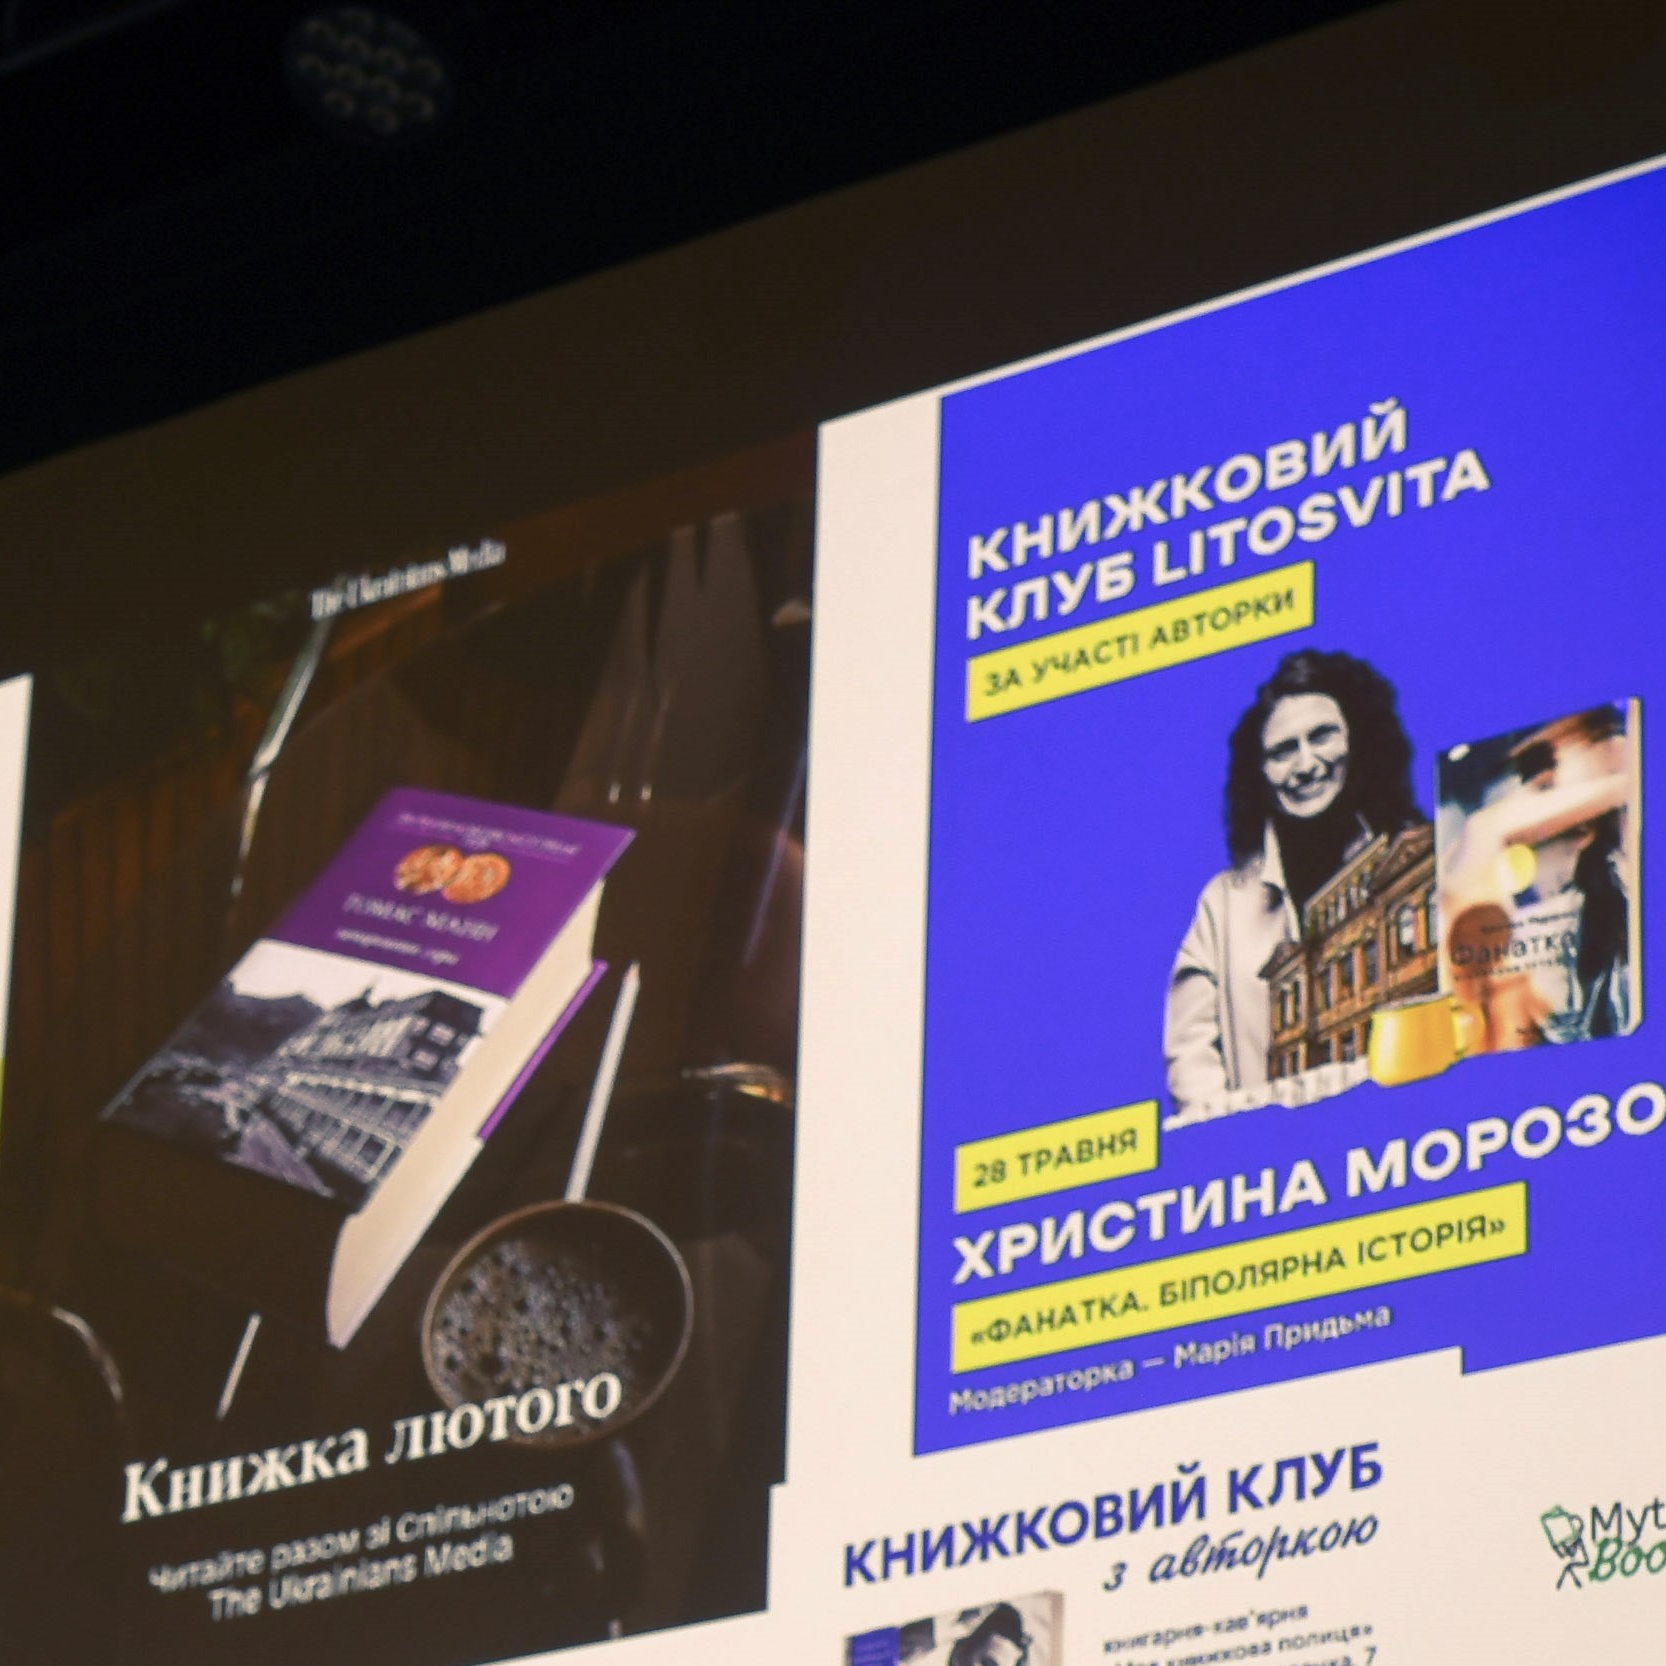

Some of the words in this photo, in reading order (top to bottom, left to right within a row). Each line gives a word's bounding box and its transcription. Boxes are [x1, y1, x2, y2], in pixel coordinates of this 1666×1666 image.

[967, 551, 1135, 640] КЛУБ
[1153, 448, 1491, 586] LITOSVITA
[969, 397, 1407, 579] КНИЖКОВИЙ
[984, 665, 1023, 698] ЗА
[1032, 634, 1140, 684] УЧАСТІ
[1149, 589, 1295, 650] АВТОРКИ
[973, 1159, 1007, 1188] 28
[1017, 1128, 1138, 1179] ТРАВНЯ
[952, 1159, 1328, 1285] ХРИСТИНА
[970, 1291, 1149, 1345] «ФАНАТКА.
[1159, 1247, 1347, 1307] БІПОЛЯРНА
[1357, 1215, 1507, 1266] ІСТОРІЯ»
[949, 1355, 1135, 1416] Модераторка
[1173, 1330, 1256, 1369] Марія
[1264, 1304, 1393, 1352] Придьма
[121, 1427, 369, 1523] Книжка
[385, 1371, 622, 1465] лютого
[149, 1548, 265, 1594] Читайте
[270, 1528, 360, 1572] разом
[843, 1461, 1208, 1589] КНИЖКОВИЙ
[1228, 1441, 1384, 1515] КЛУБ
[1102, 1559, 1130, 1593] з
[1147, 1511, 1379, 1586] авторкою
[208, 1585, 262, 1622] The
[268, 1552, 418, 1610] Ukrainians
[424, 1532, 513, 1577] Media
